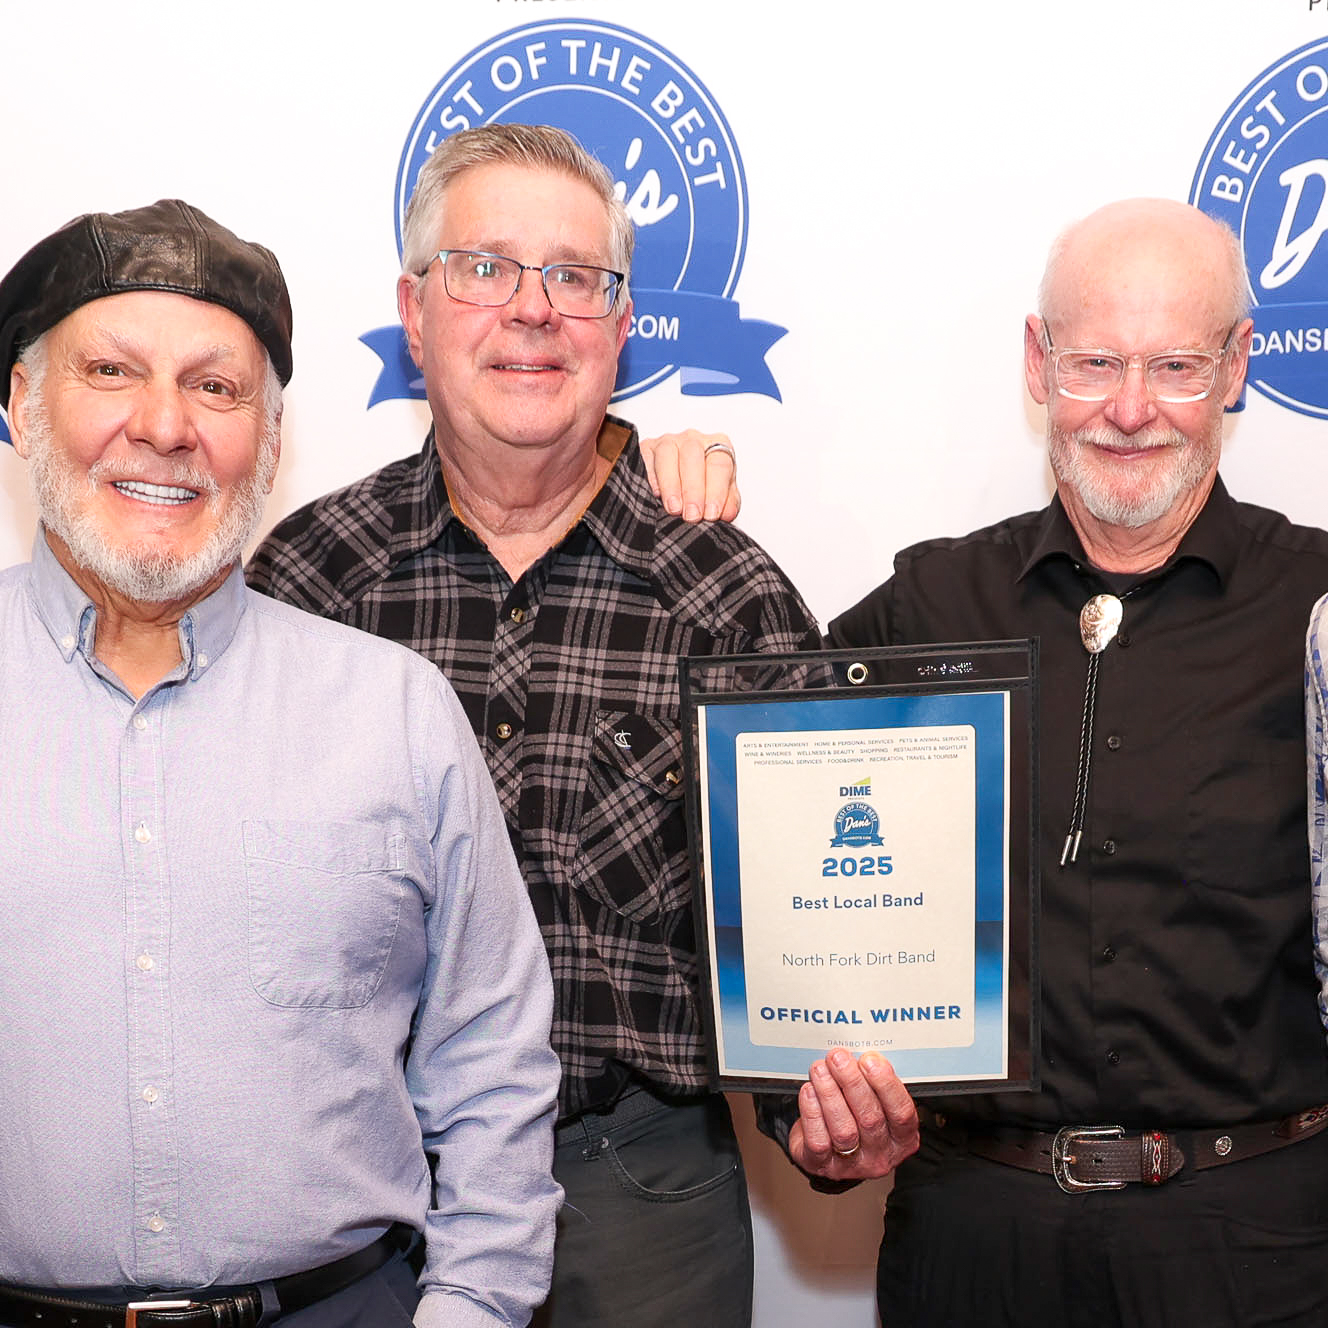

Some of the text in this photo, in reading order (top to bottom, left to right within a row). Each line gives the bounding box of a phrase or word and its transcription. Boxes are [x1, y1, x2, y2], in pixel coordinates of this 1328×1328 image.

[490, 41, 548, 92] OF
[561, 38, 651, 95] THE
[650, 81, 726, 190] BEST
[1211, 90, 1286, 202] BEST
[839, 785, 872, 797] DIME
[822, 855, 894, 877] 2025
[792, 892, 924, 910] Best Local Band
[782, 949, 936, 967] North Fork Dirt Band
[760, 1005, 962, 1025] OFFICIAL WINNER
